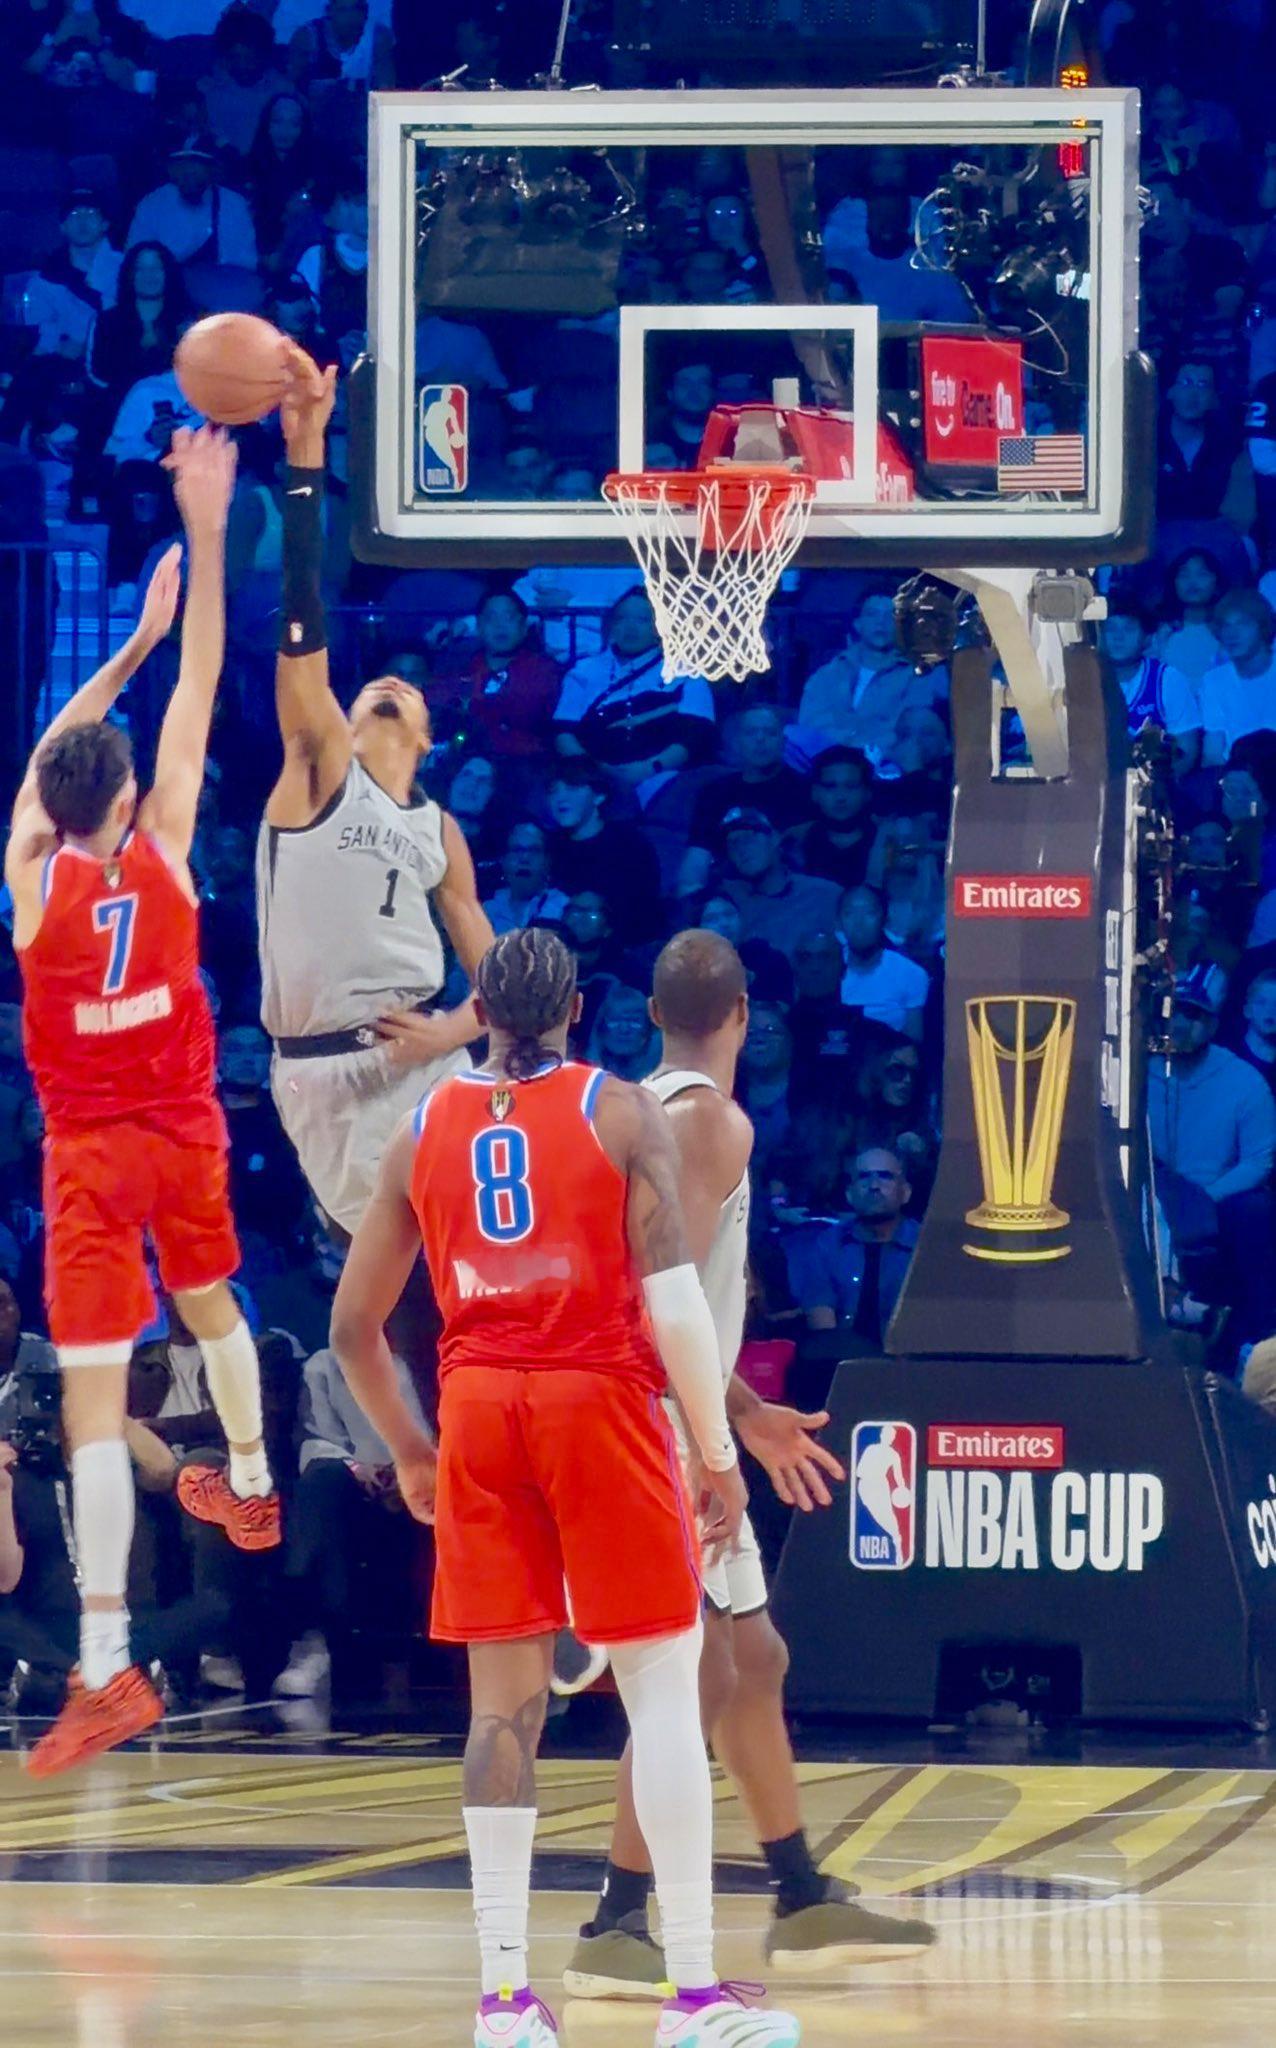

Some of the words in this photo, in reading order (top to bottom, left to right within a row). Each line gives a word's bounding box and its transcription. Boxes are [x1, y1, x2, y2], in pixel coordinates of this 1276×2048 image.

[337, 825, 379, 850] SAN
[383, 828, 425, 869] ANTO
[378, 868, 399, 918] 1
[963, 881, 1082, 908] Emirates
[92, 892, 139, 996] 7
[471, 1124, 534, 1243] 8
[937, 1431, 1055, 1458] Emirates
[925, 1470, 1039, 1569] NBA
[1051, 1471, 1163, 1571] CUP
[859, 1535, 890, 1559] NBA
